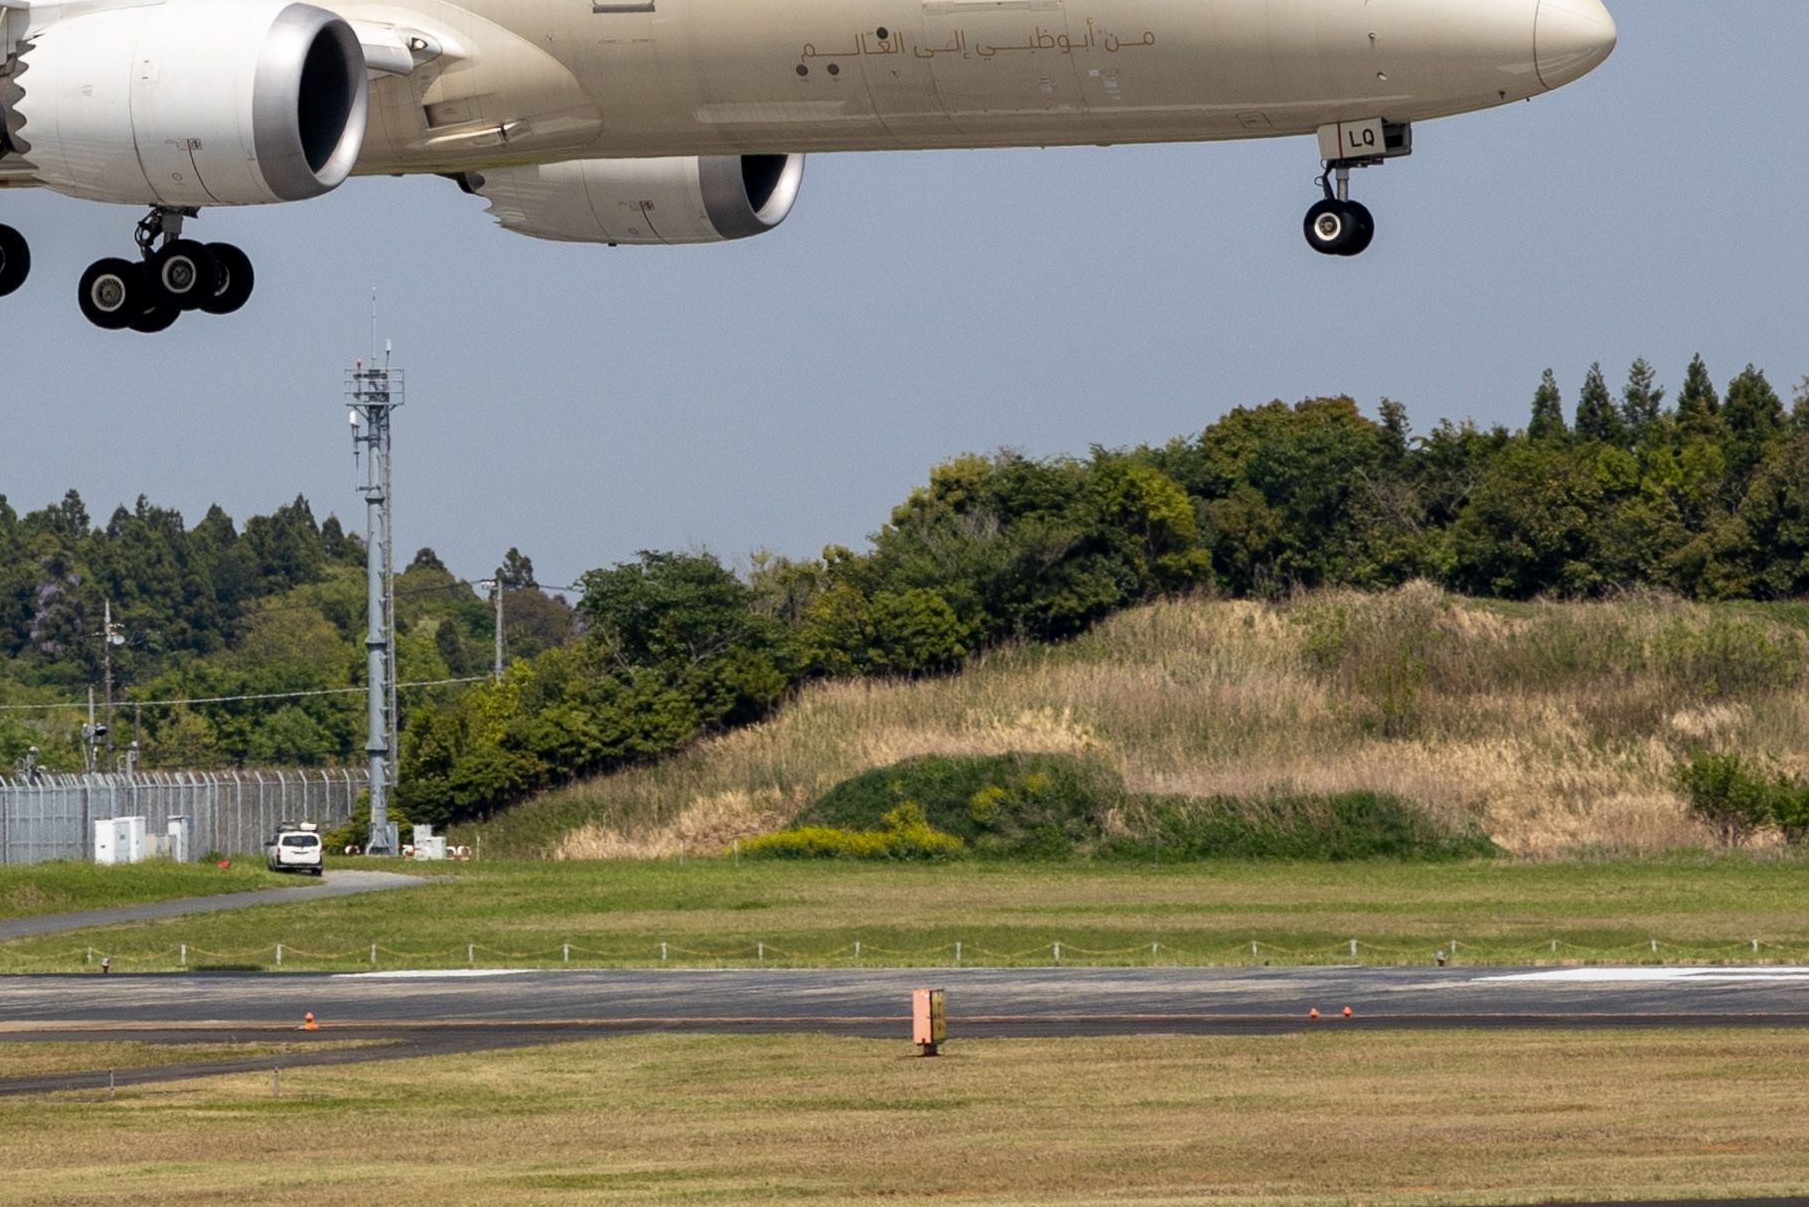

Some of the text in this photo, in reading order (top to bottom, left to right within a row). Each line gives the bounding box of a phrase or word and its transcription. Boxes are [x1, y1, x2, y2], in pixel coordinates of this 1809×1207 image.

[801, 17, 1155, 63] من أبوظبي إلى العالم
[1348, 128, 1375, 148] LQ
